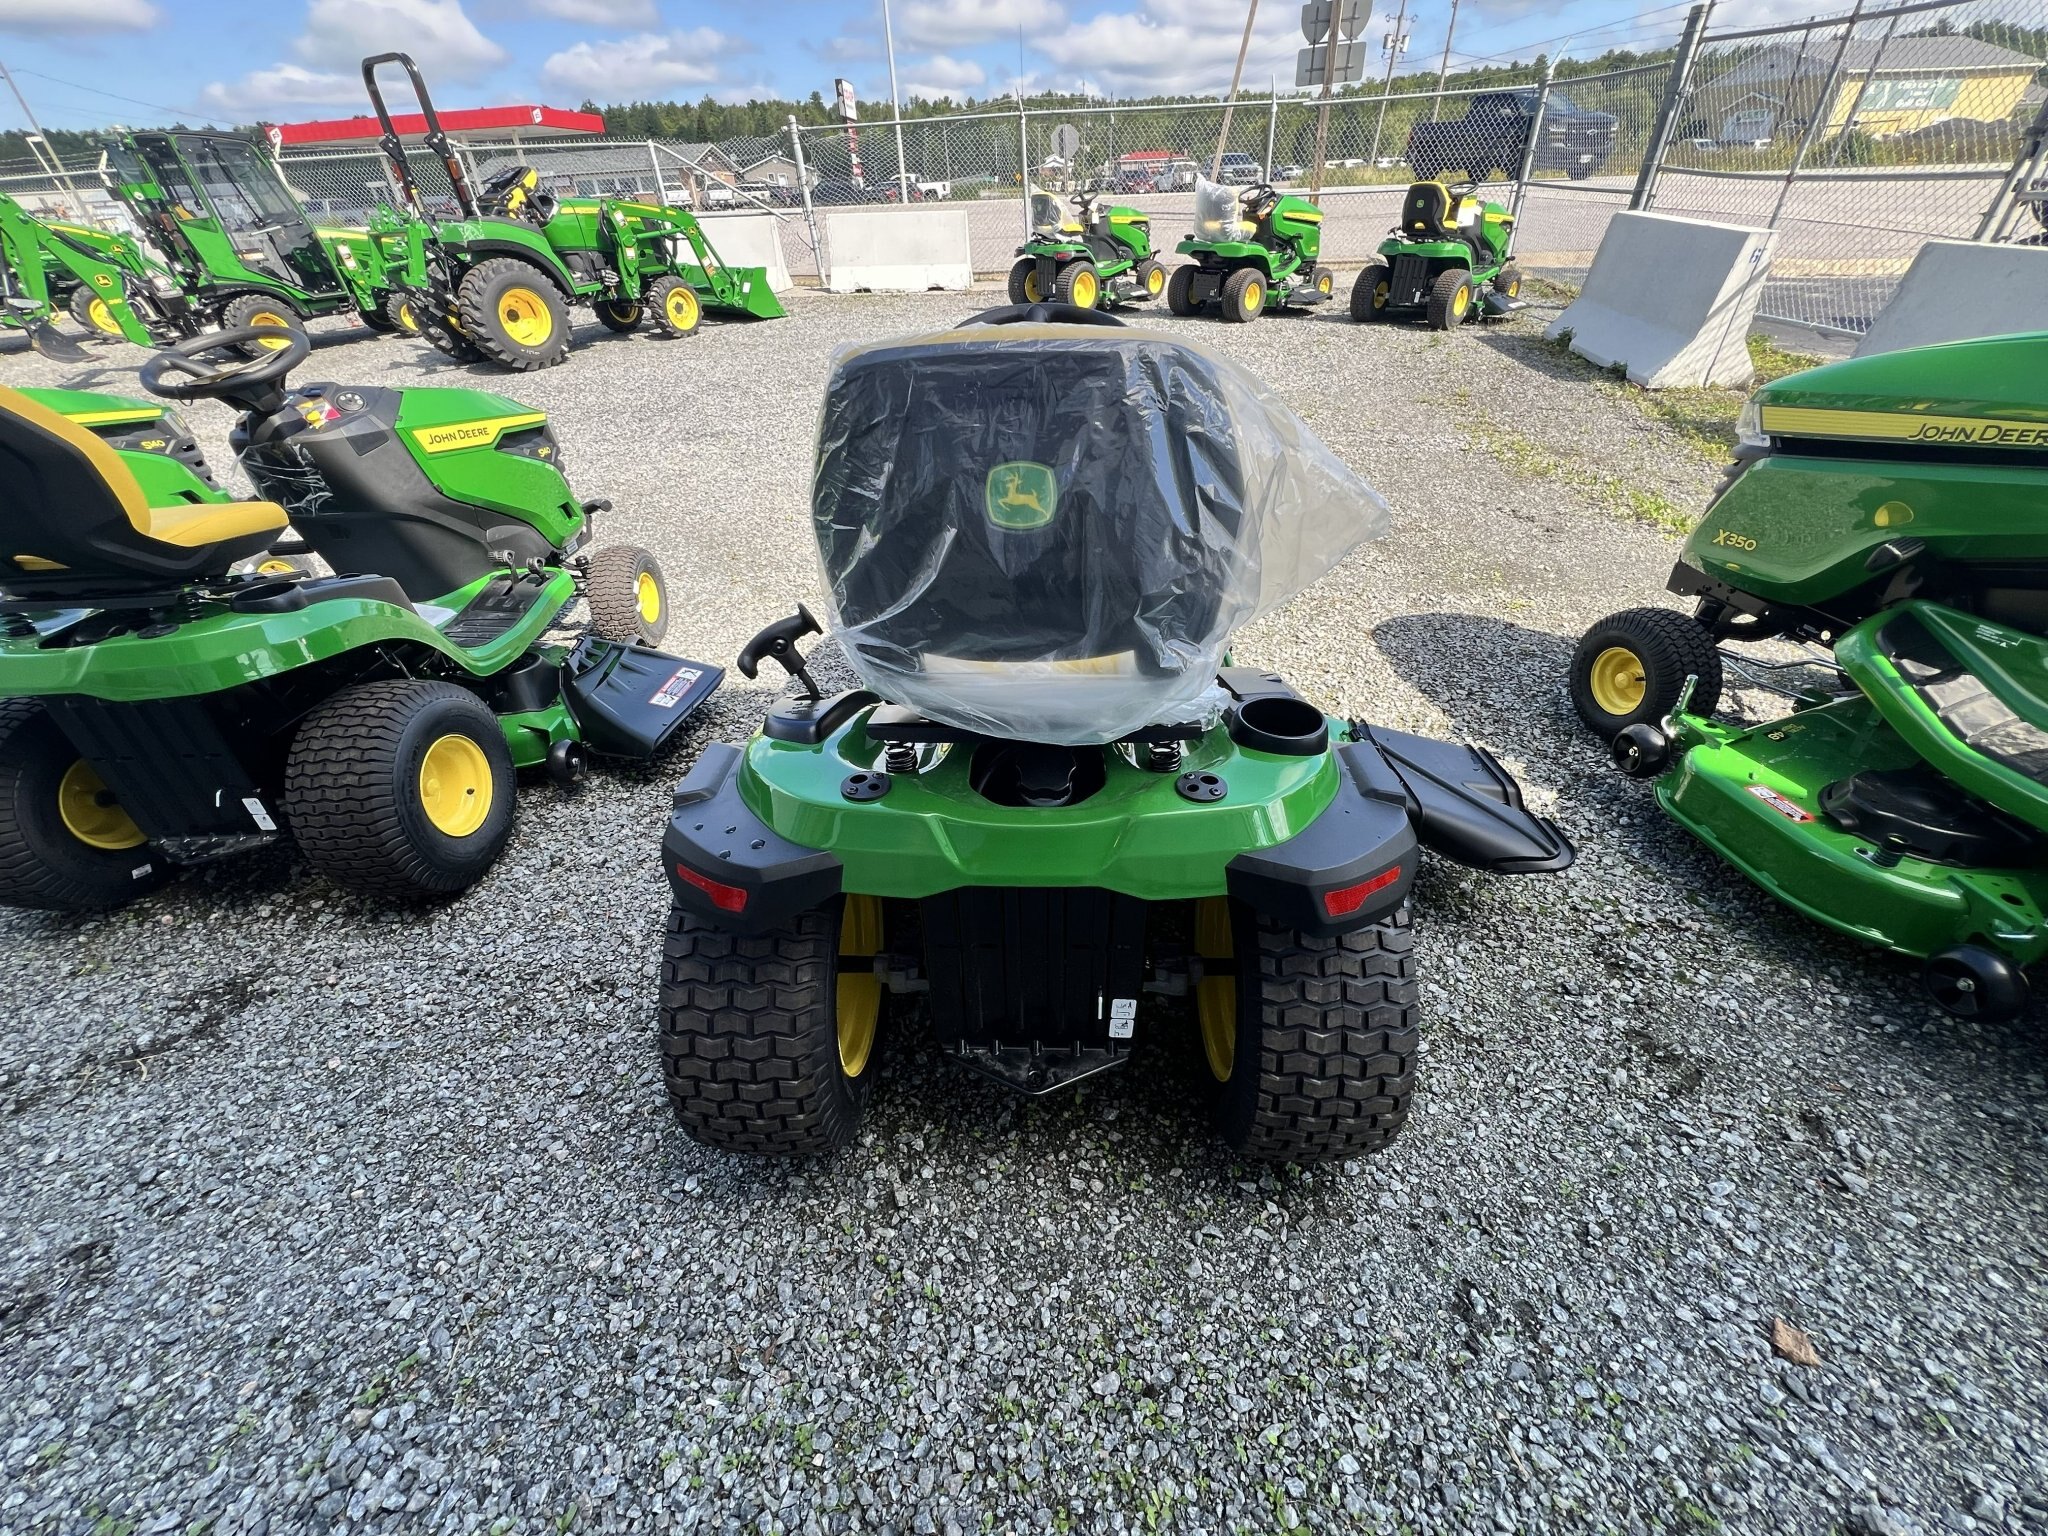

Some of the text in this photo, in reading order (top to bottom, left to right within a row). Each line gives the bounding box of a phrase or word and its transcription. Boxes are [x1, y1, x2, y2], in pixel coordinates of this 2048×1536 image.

[428, 427, 490, 445] JOHN DEERE
[1907, 422, 2048, 444] JOHN DEER
[1711, 528, 1757, 551] X350
